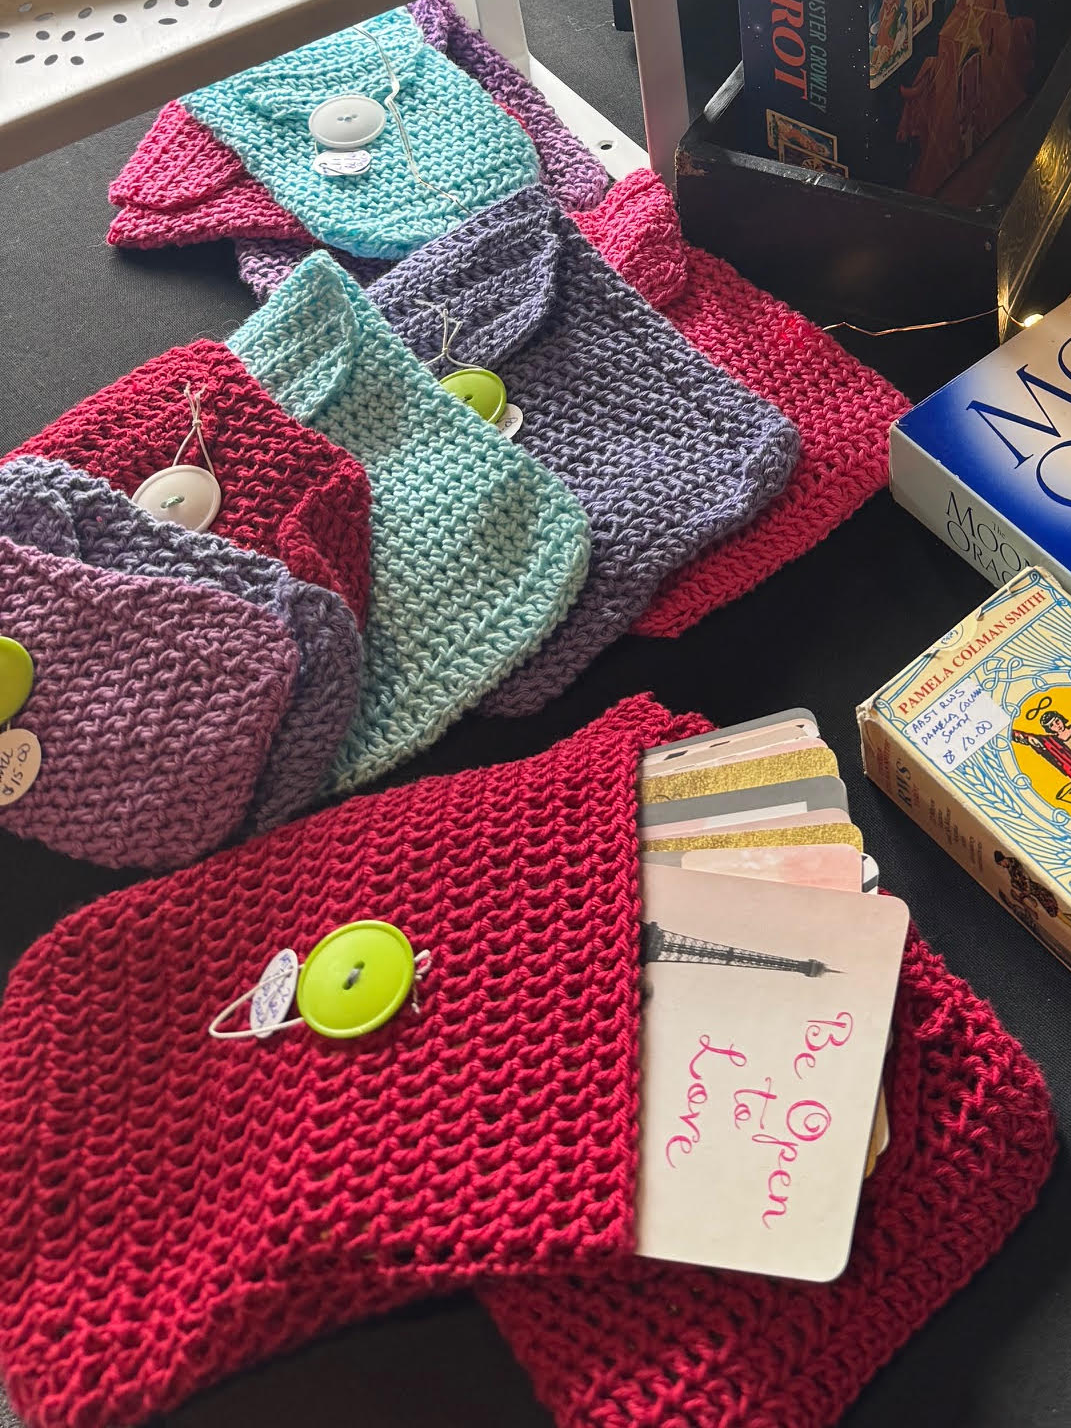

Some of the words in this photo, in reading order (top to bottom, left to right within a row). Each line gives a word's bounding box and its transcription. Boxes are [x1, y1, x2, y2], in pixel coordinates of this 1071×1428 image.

[808, 43, 829, 114] CROWLEY
[898, 666, 955, 715] PAMELA
[951, 620, 1007, 669] COLMAN
[1004, 589, 1045, 627] SMITH
[793, 1010, 854, 1081] Be
[665, 1032, 750, 1169] Love
[730, 1076, 777, 1131] to
[753, 1097, 832, 1230] Open
